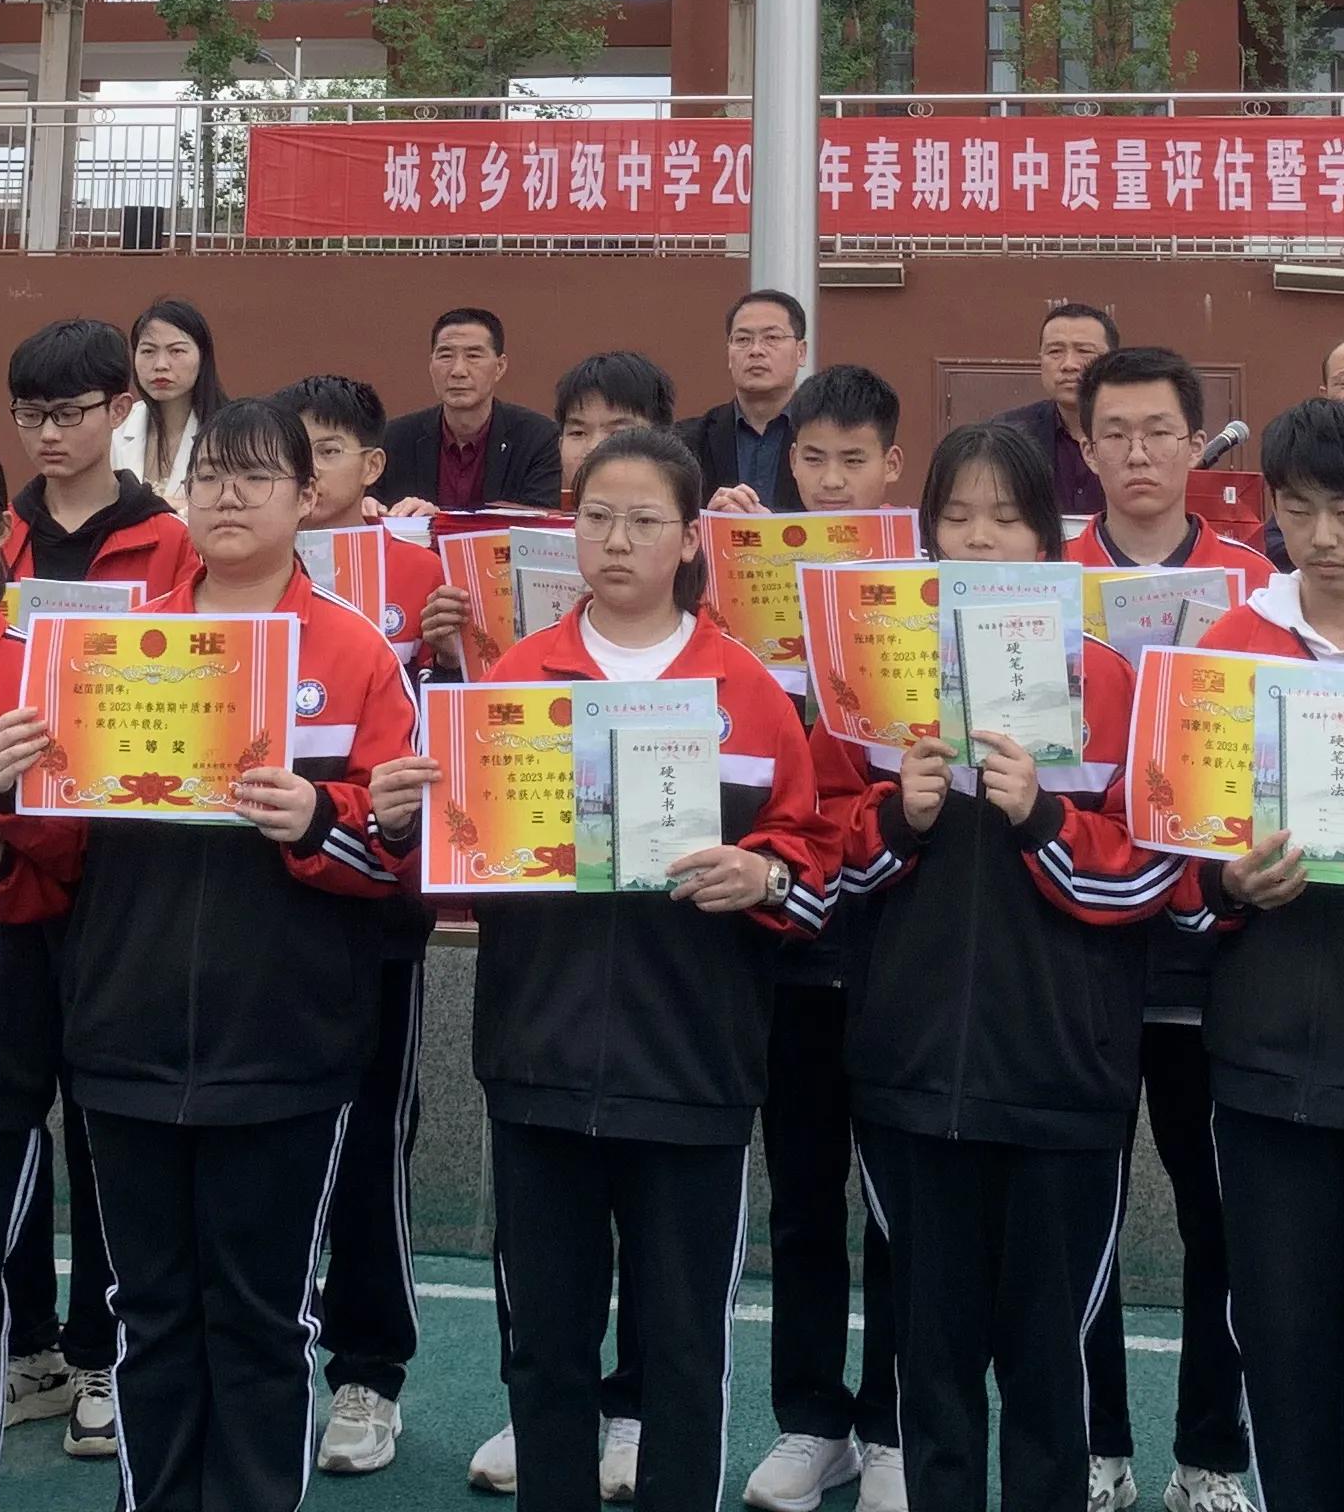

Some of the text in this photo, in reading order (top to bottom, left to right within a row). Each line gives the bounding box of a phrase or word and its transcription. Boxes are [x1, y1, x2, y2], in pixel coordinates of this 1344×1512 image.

[1006, 642, 1026, 702] 硬笔书法
[118, 740, 186, 754] 三等奖
[659, 765, 677, 827] 硬笔书法
